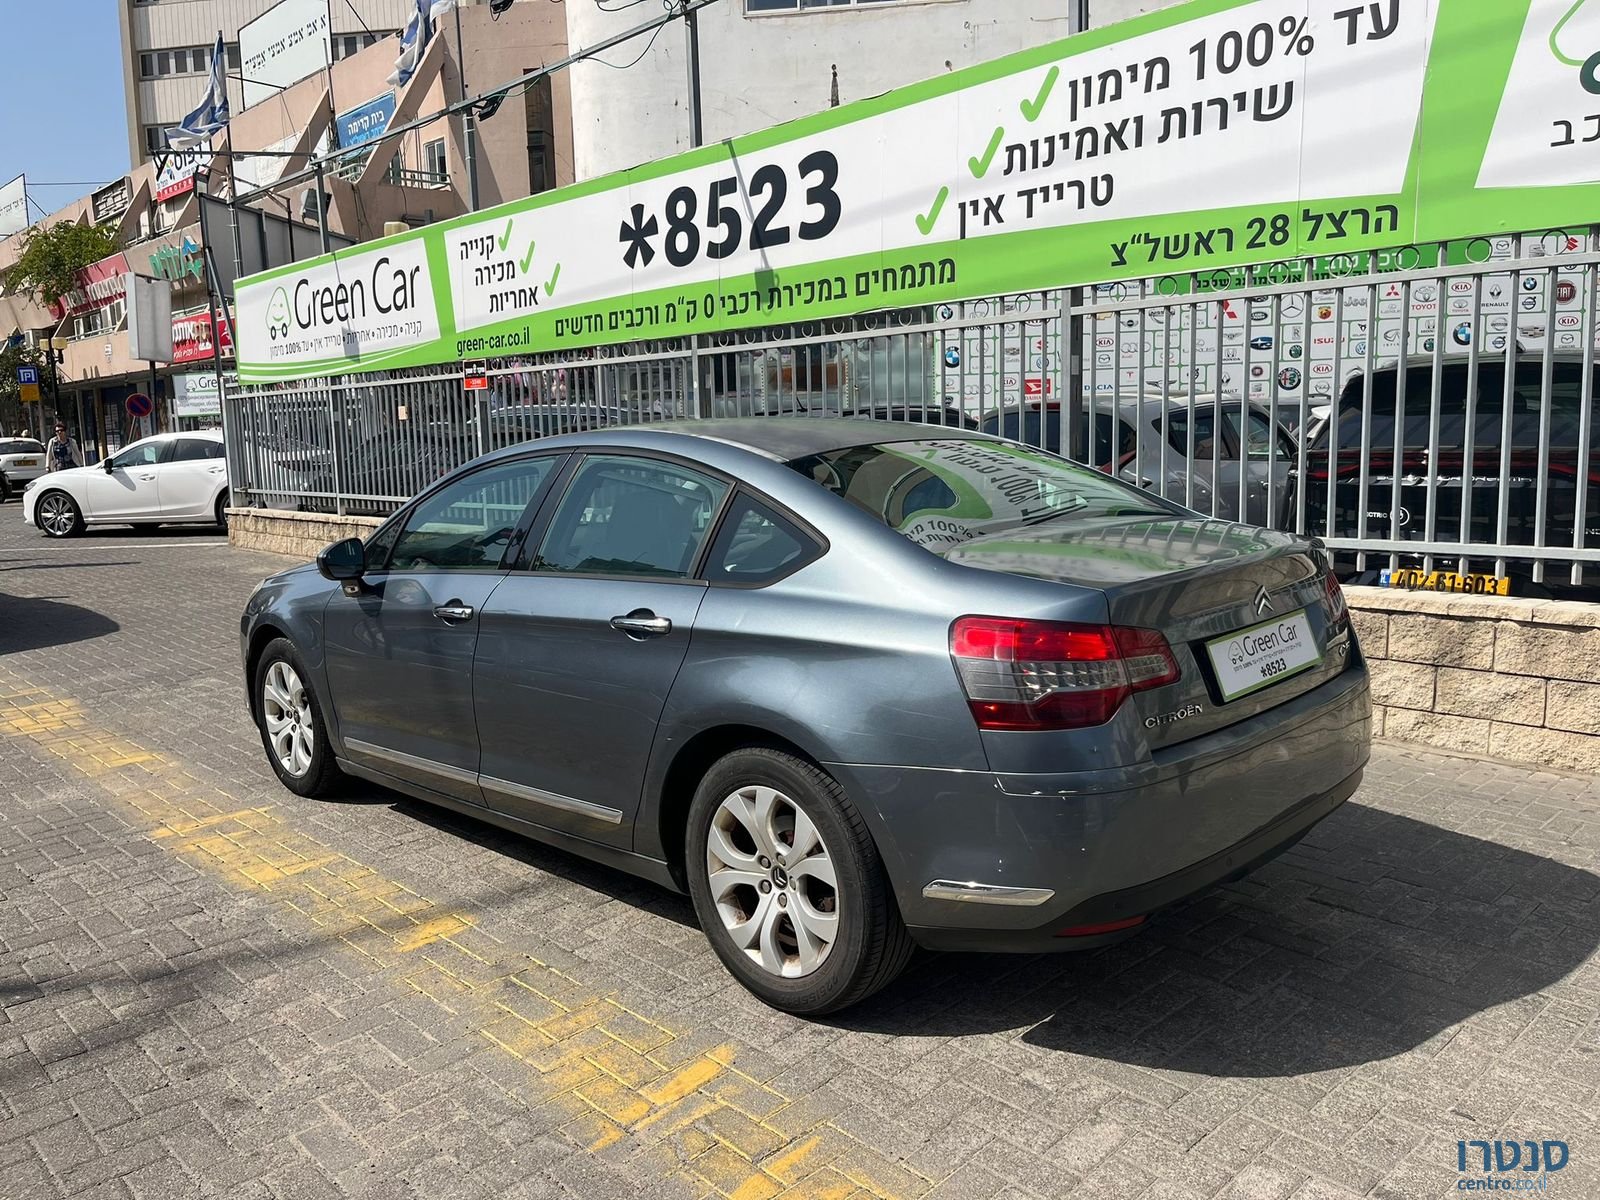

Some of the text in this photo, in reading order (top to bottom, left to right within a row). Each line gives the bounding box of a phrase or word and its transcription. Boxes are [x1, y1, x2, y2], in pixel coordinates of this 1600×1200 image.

[1068, 0, 1400, 121] עד 100% מימון
[347, 110, 385, 136] בית קדימה
[1003, 81, 1294, 176] שירות ואמינות
[958, 173, 1114, 239] טרייד אין
[1246, 214, 1289, 251] 28
[1302, 203, 1400, 242] הרצל
[460, 234, 495, 260] קנייה
[475, 260, 516, 286] מכירה
[855, 258, 957, 295] מתמחים
[294, 257, 420, 330] Green Car
[489, 286, 539, 313] אחריות
[720, 288, 761, 317] רכבי
[767, 276, 847, 310] במכירת
[1411, 303, 1436, 311] TOYOT
[403, 320, 423, 337] קניה
[555, 311, 604, 338] חדשים
[609, 304, 660, 330] ורכבים
[376, 324, 399, 340] מכירה
[456, 326, 530, 357] green-car.co.il
[285, 341, 301, 355] 100%
[1243, 632, 1280, 657] Green
[1278, 623, 1298, 643] Car
[1144, 703, 1203, 729] CITROËN
